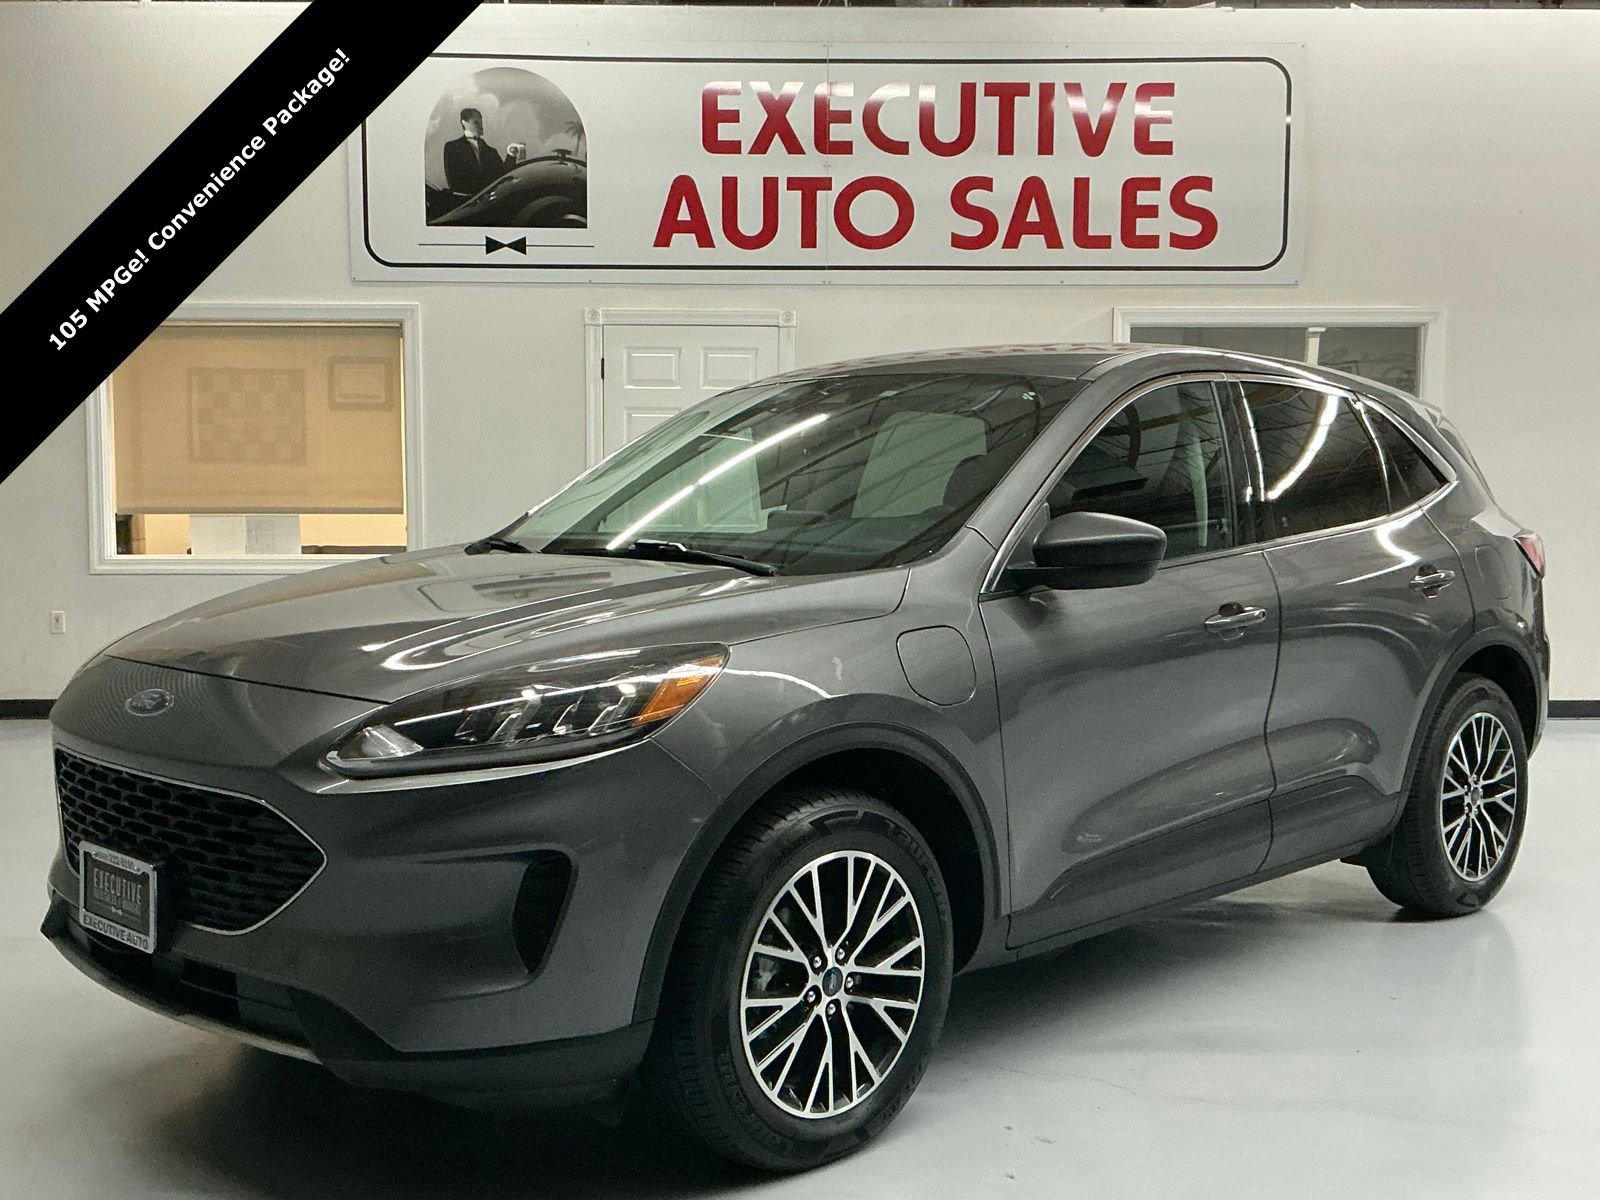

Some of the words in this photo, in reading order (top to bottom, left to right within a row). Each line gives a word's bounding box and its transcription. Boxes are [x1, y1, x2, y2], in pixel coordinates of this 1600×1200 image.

[701, 81, 1175, 157] EXECUTIVE
[653, 174, 915, 250] AUTO
[950, 175, 1218, 250] SALES
[93, 867, 142, 904] EXECUTIVE
